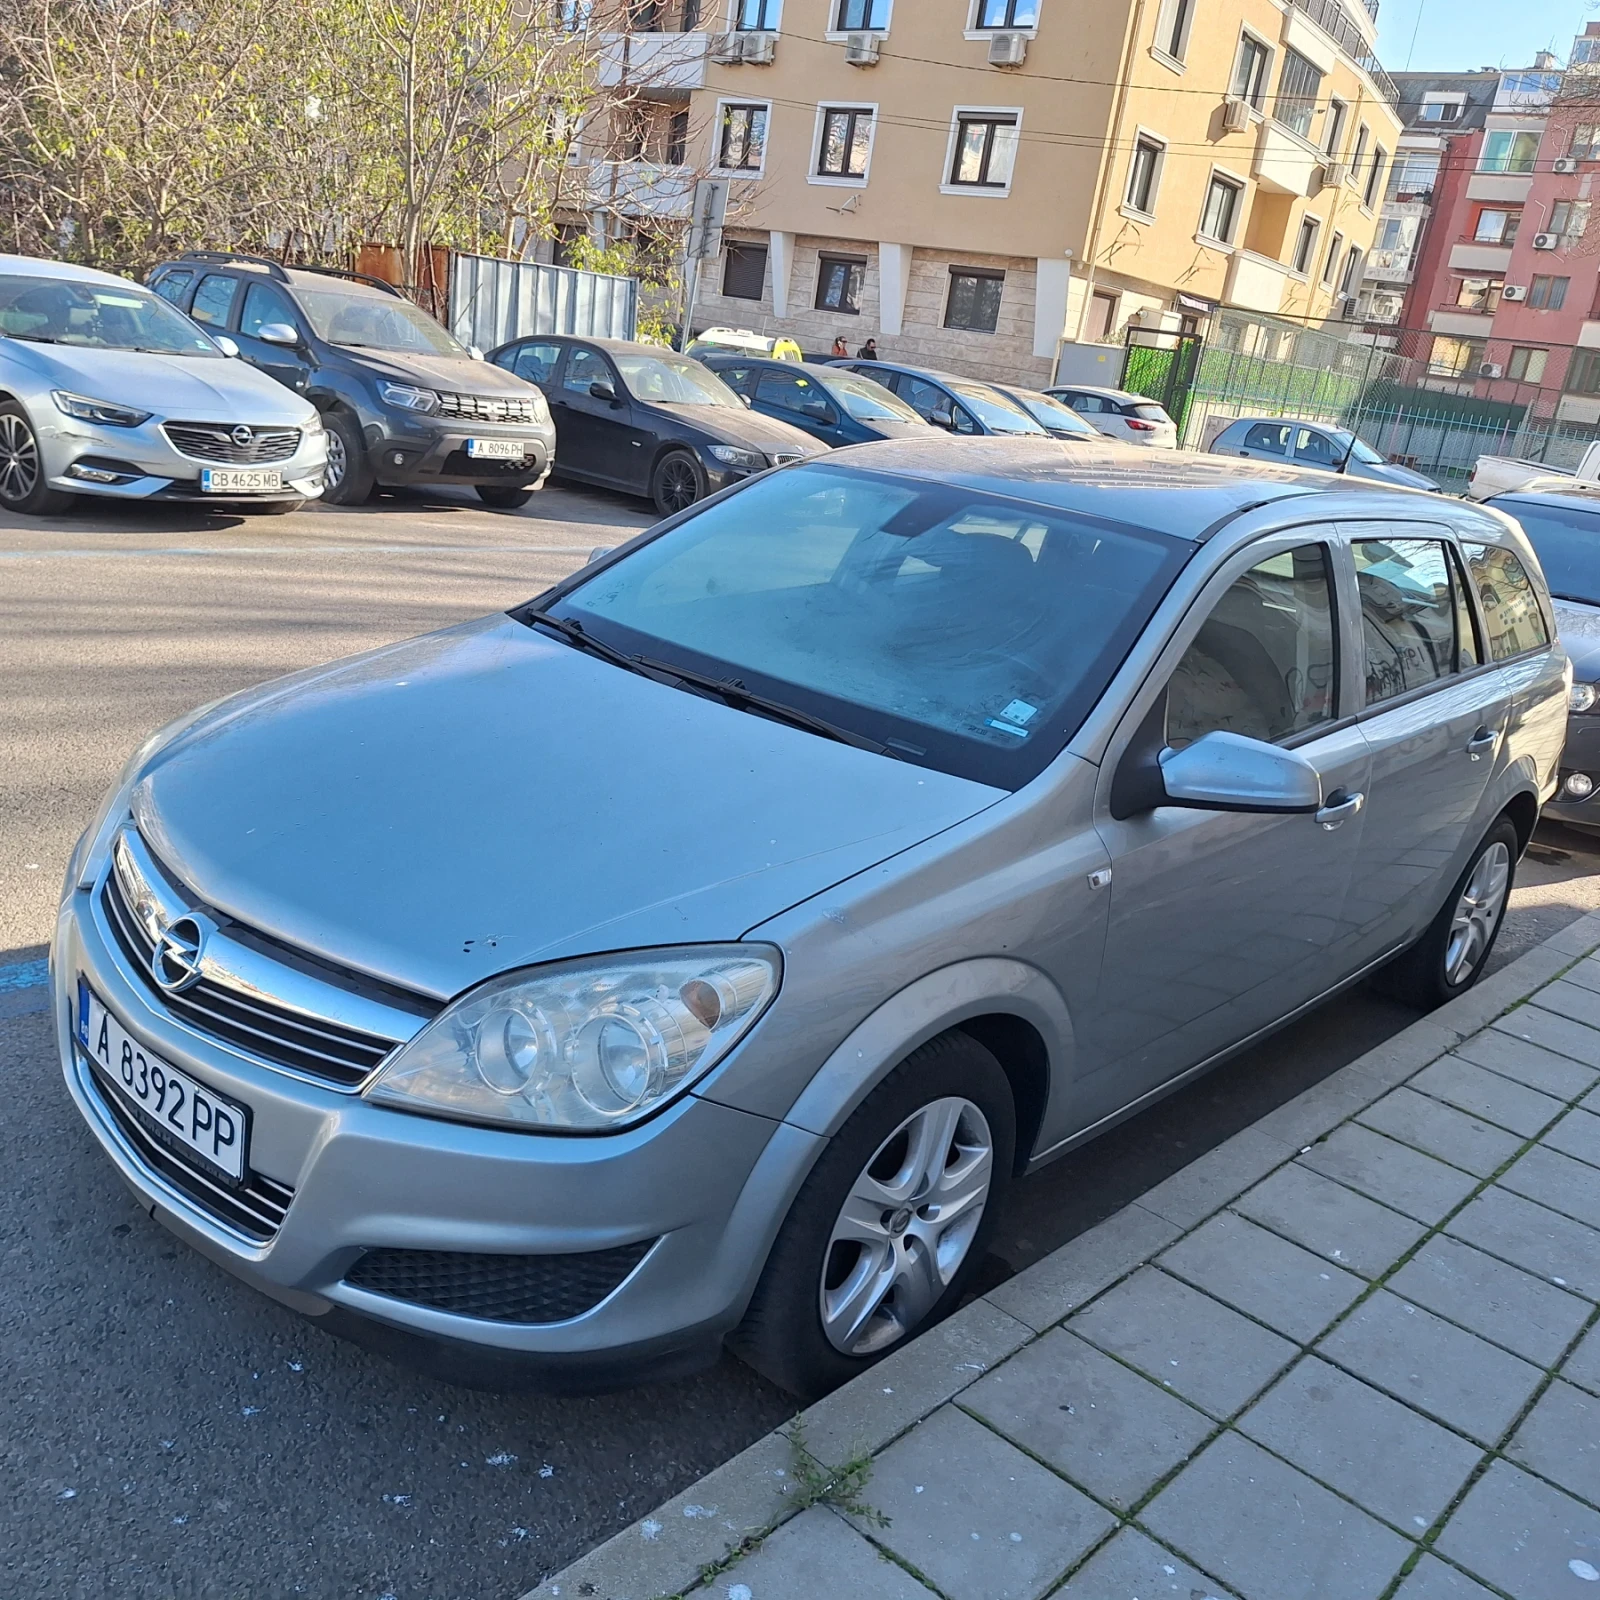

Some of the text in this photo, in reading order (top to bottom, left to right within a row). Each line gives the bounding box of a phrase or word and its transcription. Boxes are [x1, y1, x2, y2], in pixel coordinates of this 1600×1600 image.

[478, 442, 523, 456] A 8096 PH
[212, 473, 278, 487] CB 4625 MB
[97, 1013, 110, 1065] A
[121, 1039, 185, 1132] 8392
[191, 1092, 235, 1157] PP
